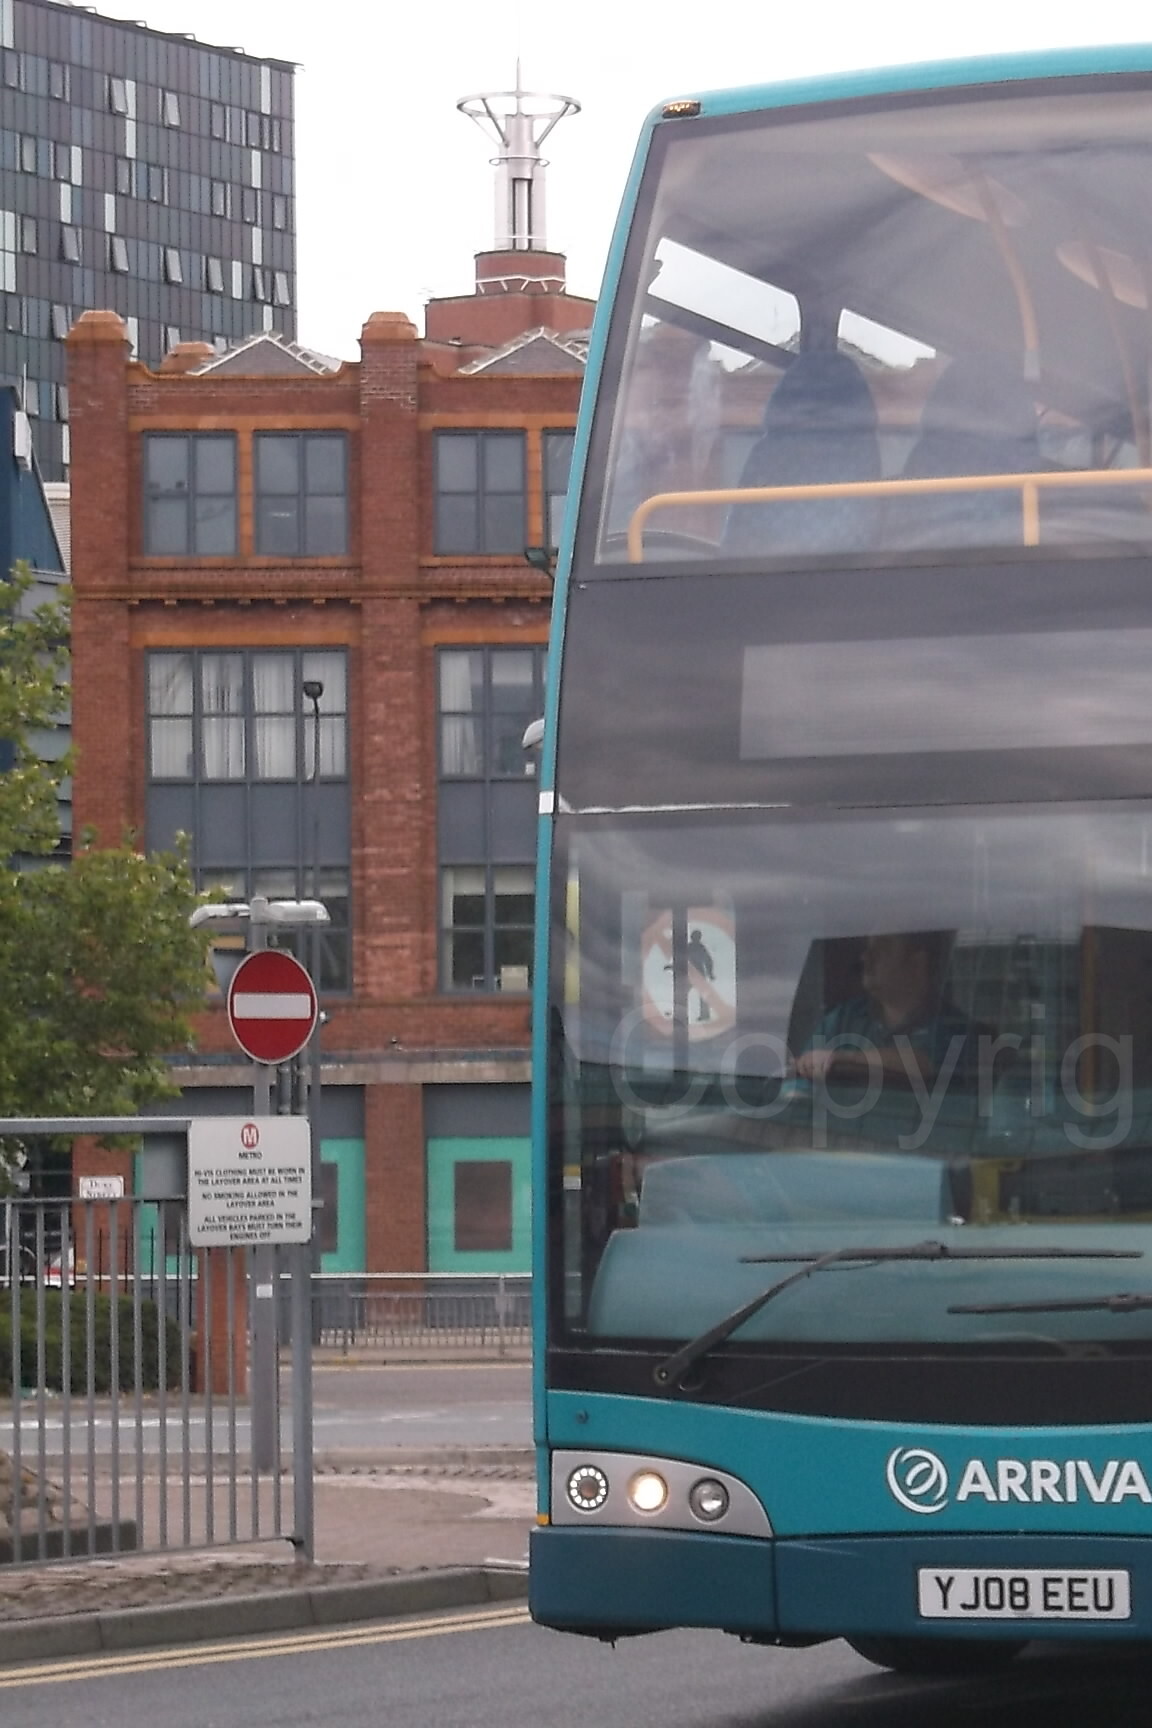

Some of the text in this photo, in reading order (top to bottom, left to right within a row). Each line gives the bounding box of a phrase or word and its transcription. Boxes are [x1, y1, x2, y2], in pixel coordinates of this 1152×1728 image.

[218, 1214, 248, 1222] VEHICLES
[197, 1224, 227, 1232] LAYOVER
[935, 1576, 1115, 1612] YJ08 EEU
